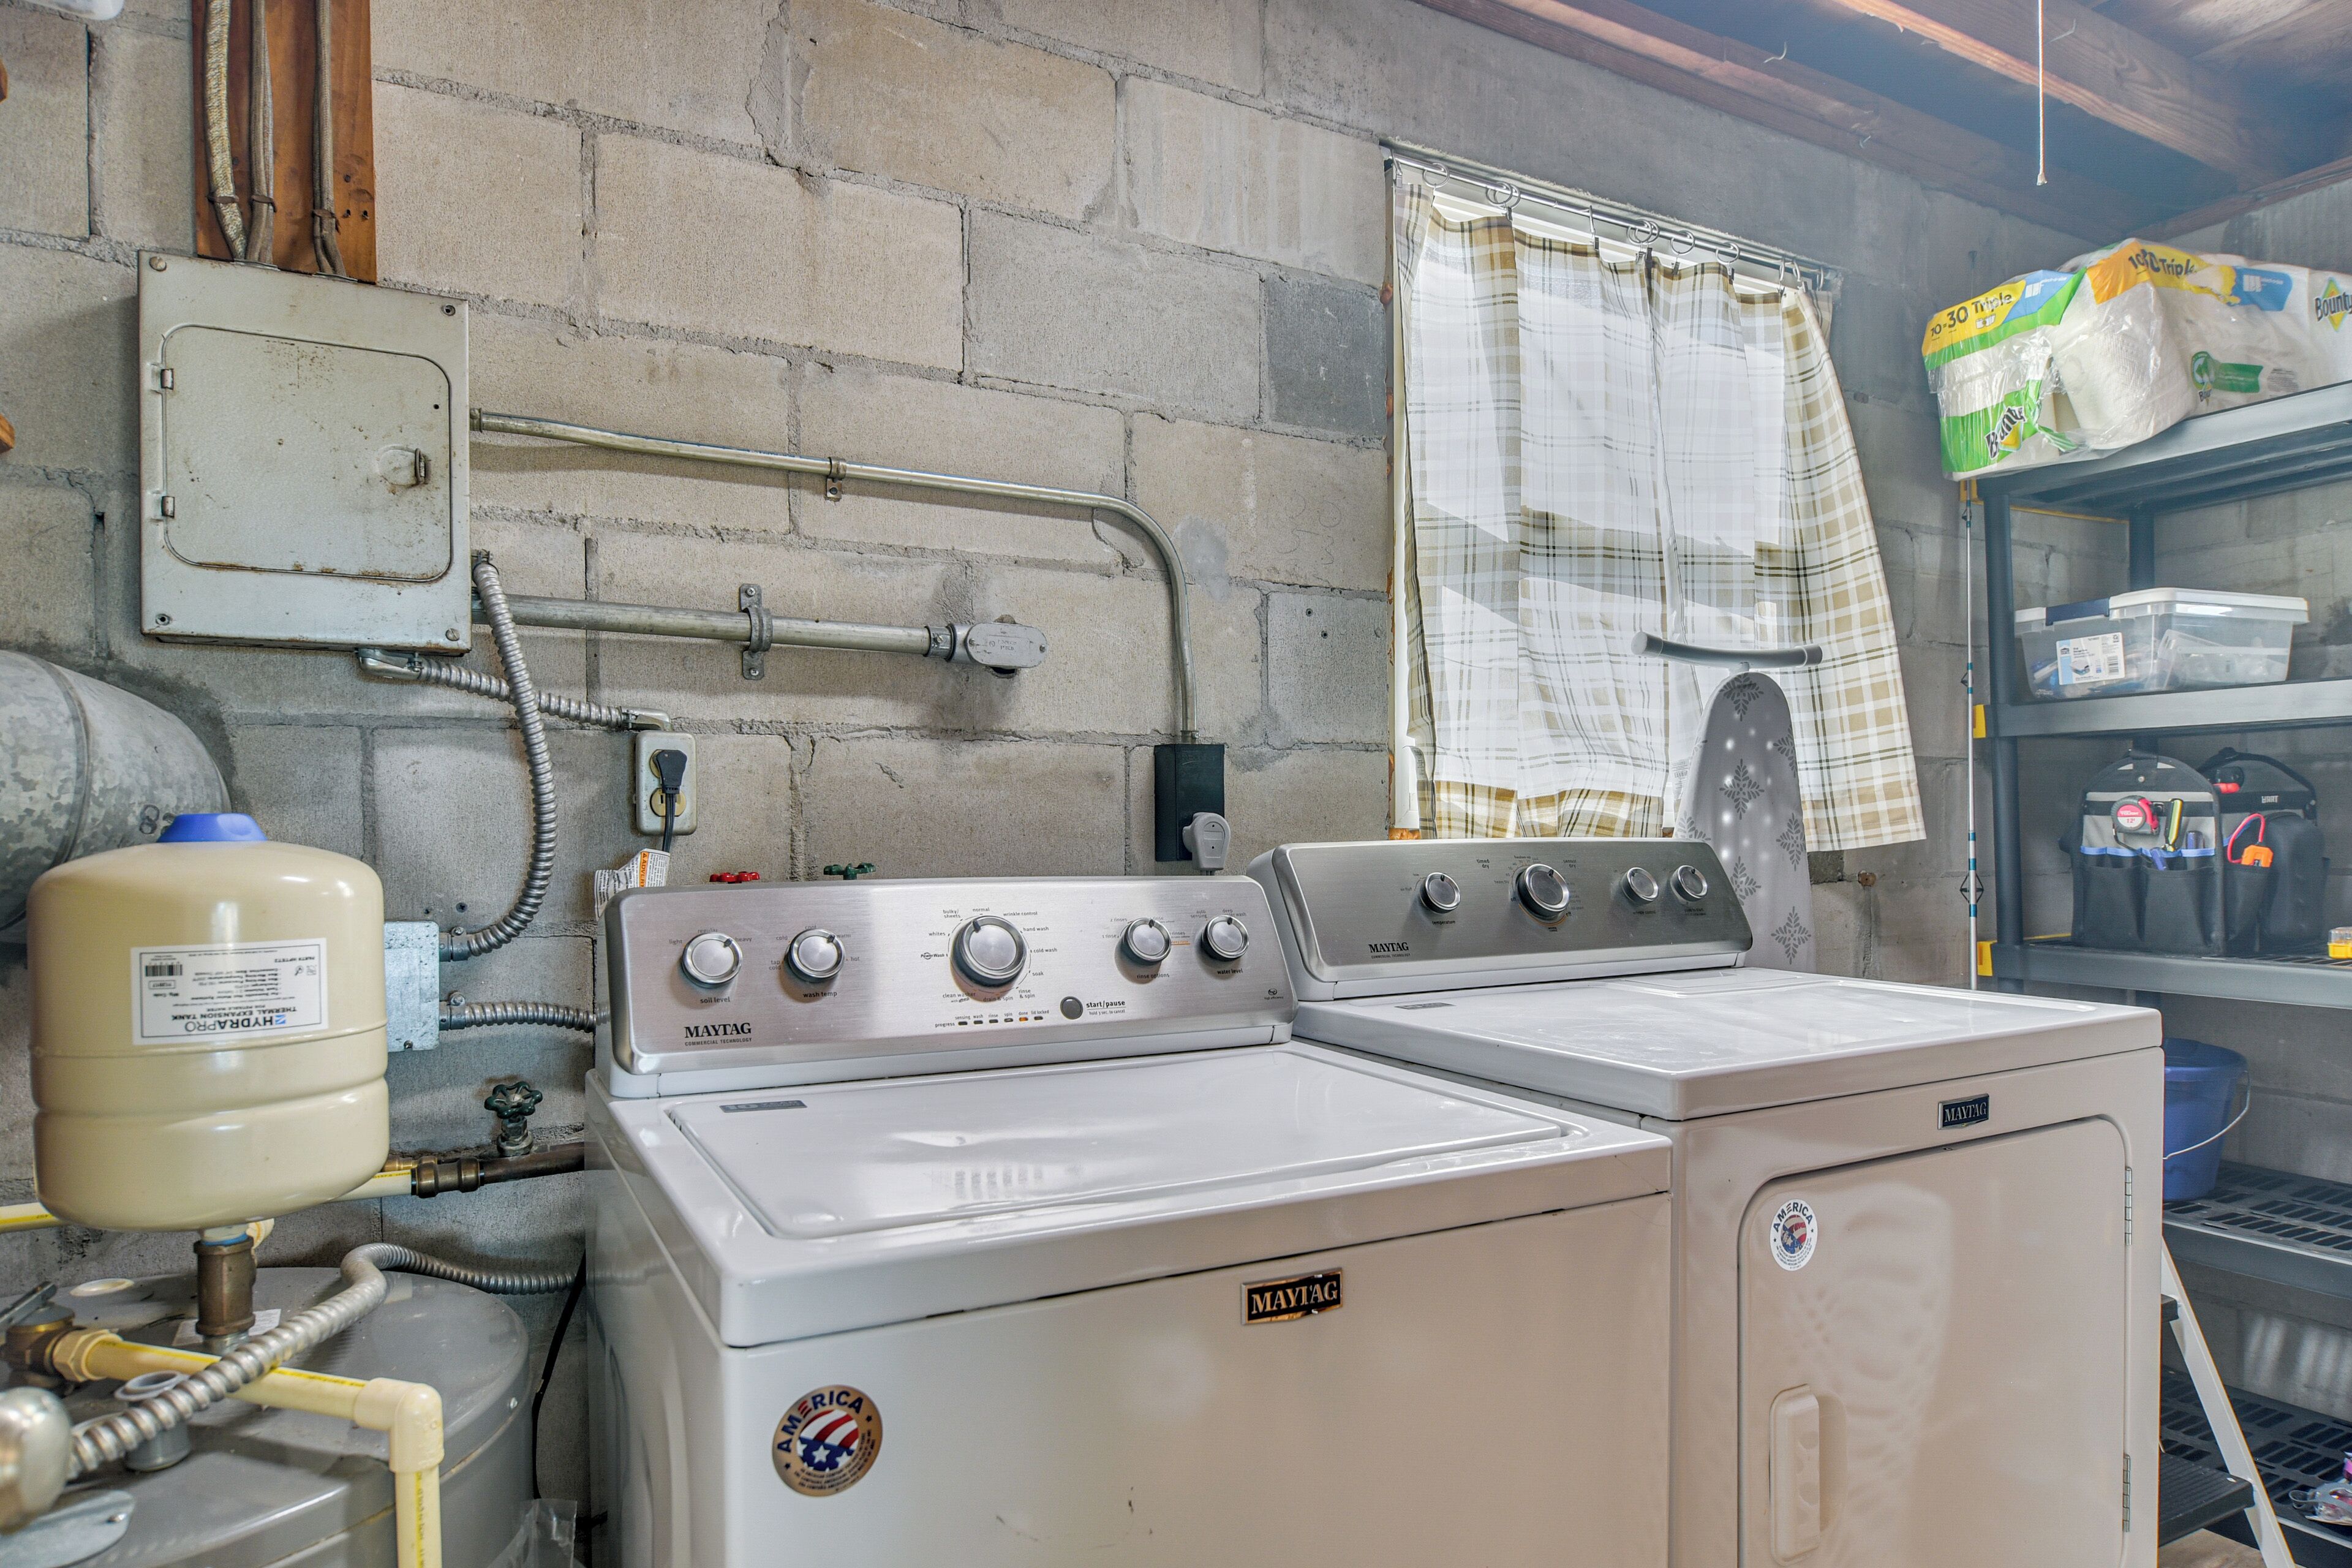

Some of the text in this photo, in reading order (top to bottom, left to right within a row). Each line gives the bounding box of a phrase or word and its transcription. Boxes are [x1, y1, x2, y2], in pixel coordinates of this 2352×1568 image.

[1931, 324, 1942, 337] 10
[1947, 306, 1969, 328] 30
[1972, 292, 2012, 314] Triple
[1368, 942, 1409, 953] MAYTAG
[1086, 1000, 1125, 1008] start/pause
[200, 1010, 253, 1019] EXPANSION
[185, 1016, 273, 1032] HYDRAPRO
[684, 1022, 752, 1038] MAYTAG
[1945, 1102, 1986, 1123] MAYTAG
[1773, 1202, 1813, 1232] AMERICA
[1251, 1281, 1338, 1314] MAYTAG
[777, 1391, 864, 1453] AMERICA
